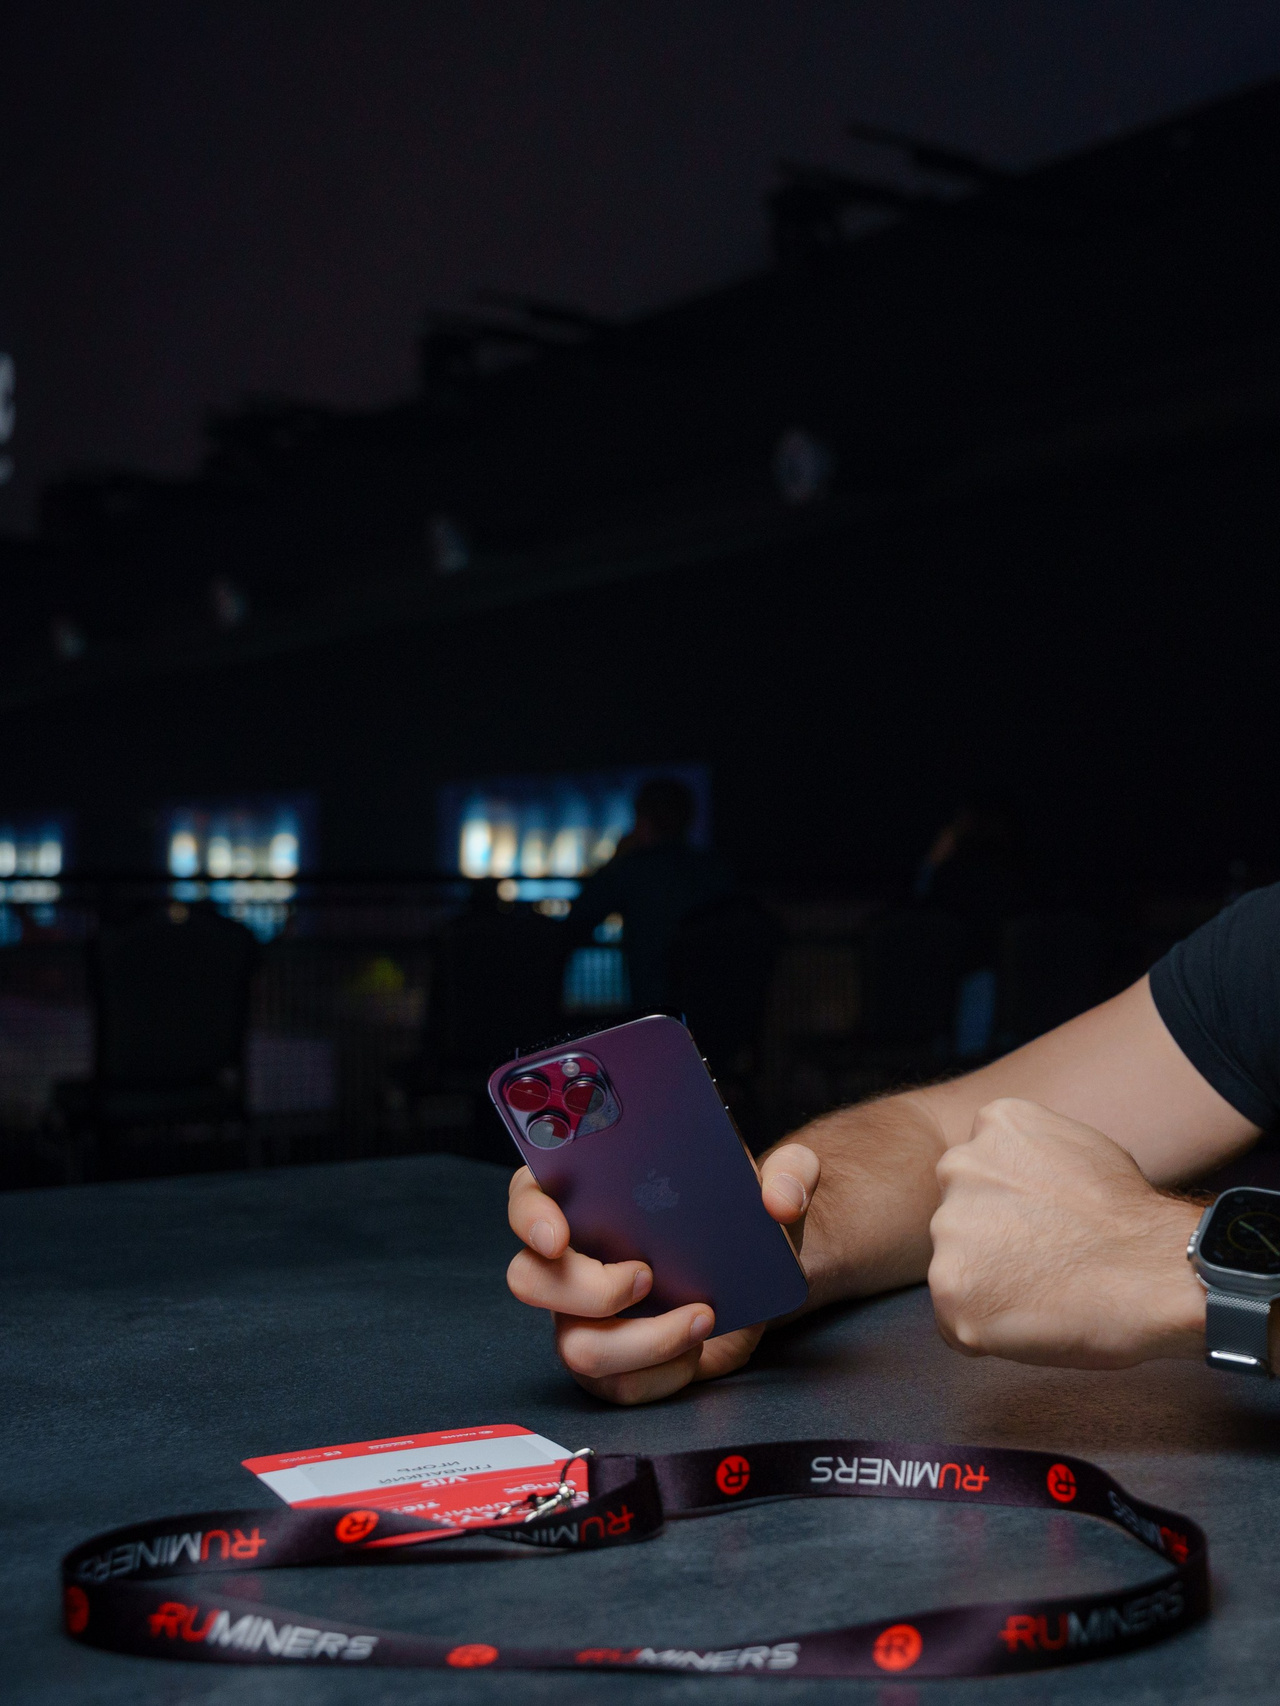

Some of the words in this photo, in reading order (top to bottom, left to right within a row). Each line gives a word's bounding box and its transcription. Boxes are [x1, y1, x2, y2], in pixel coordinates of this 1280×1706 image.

[379, 1463, 493, 1485] ГЛАВАЦКИЙ
[396, 1460, 461, 1473] ИГОРЬ
[810, 1456, 990, 1492] RUMINERS
[421, 1475, 469, 1489] VIP
[148, 1601, 379, 1661] RUMINERS
